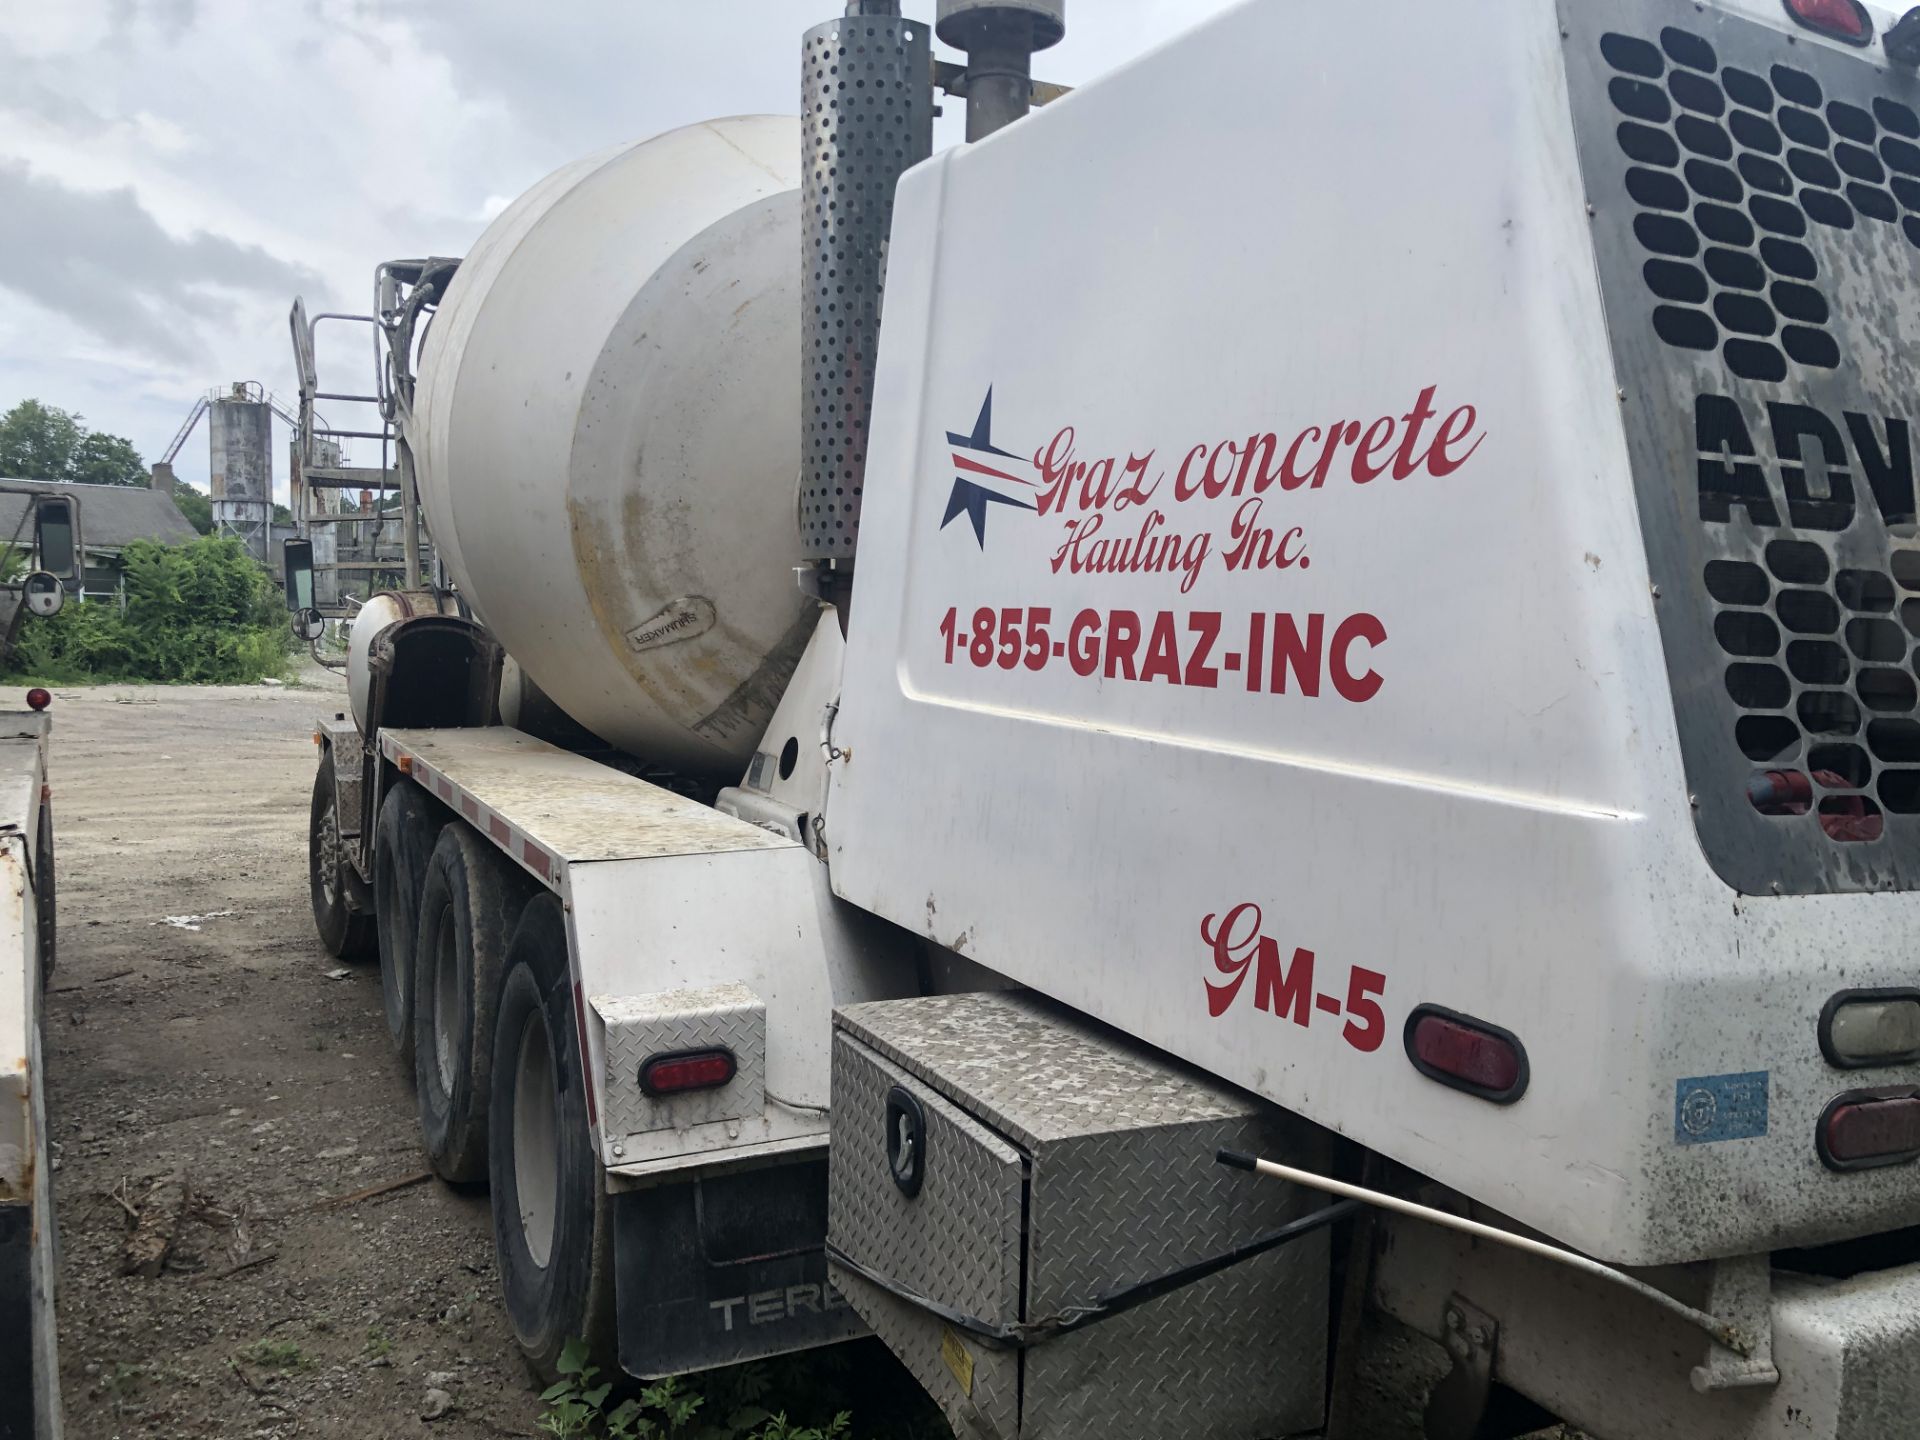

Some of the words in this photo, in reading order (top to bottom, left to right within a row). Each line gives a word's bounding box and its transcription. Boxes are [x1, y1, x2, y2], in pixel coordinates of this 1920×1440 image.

[1033, 426, 1164, 517] Graz
[1049, 509, 1212, 594] Hauling
[1222, 497, 1311, 574] Inc.
[939, 606, 1388, 704] 1-855-GRAZ-INC
[1200, 902, 1386, 1052] GM-5
